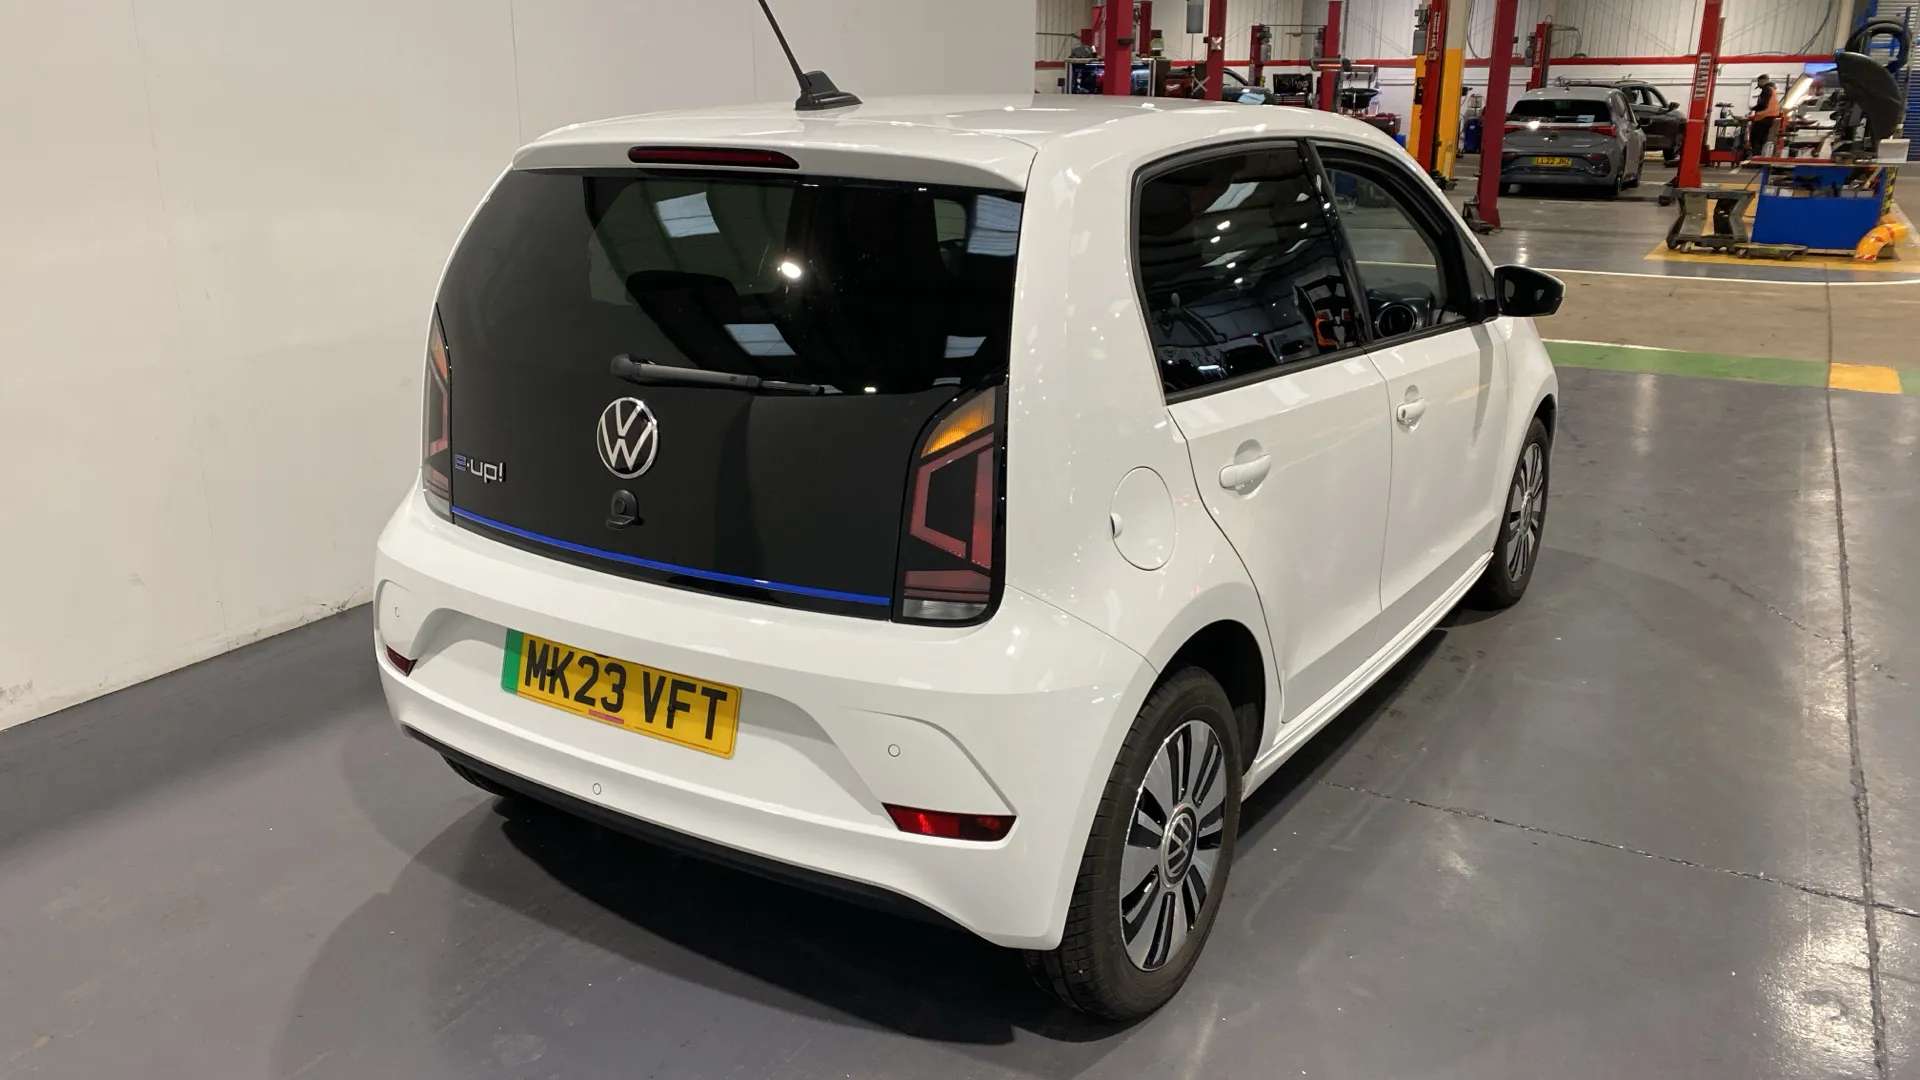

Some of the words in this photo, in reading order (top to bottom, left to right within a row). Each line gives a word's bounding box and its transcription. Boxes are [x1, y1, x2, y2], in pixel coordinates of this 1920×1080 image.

[600, 399, 654, 474] VW
[524, 639, 627, 714] MK23
[642, 671, 728, 741] VFT
